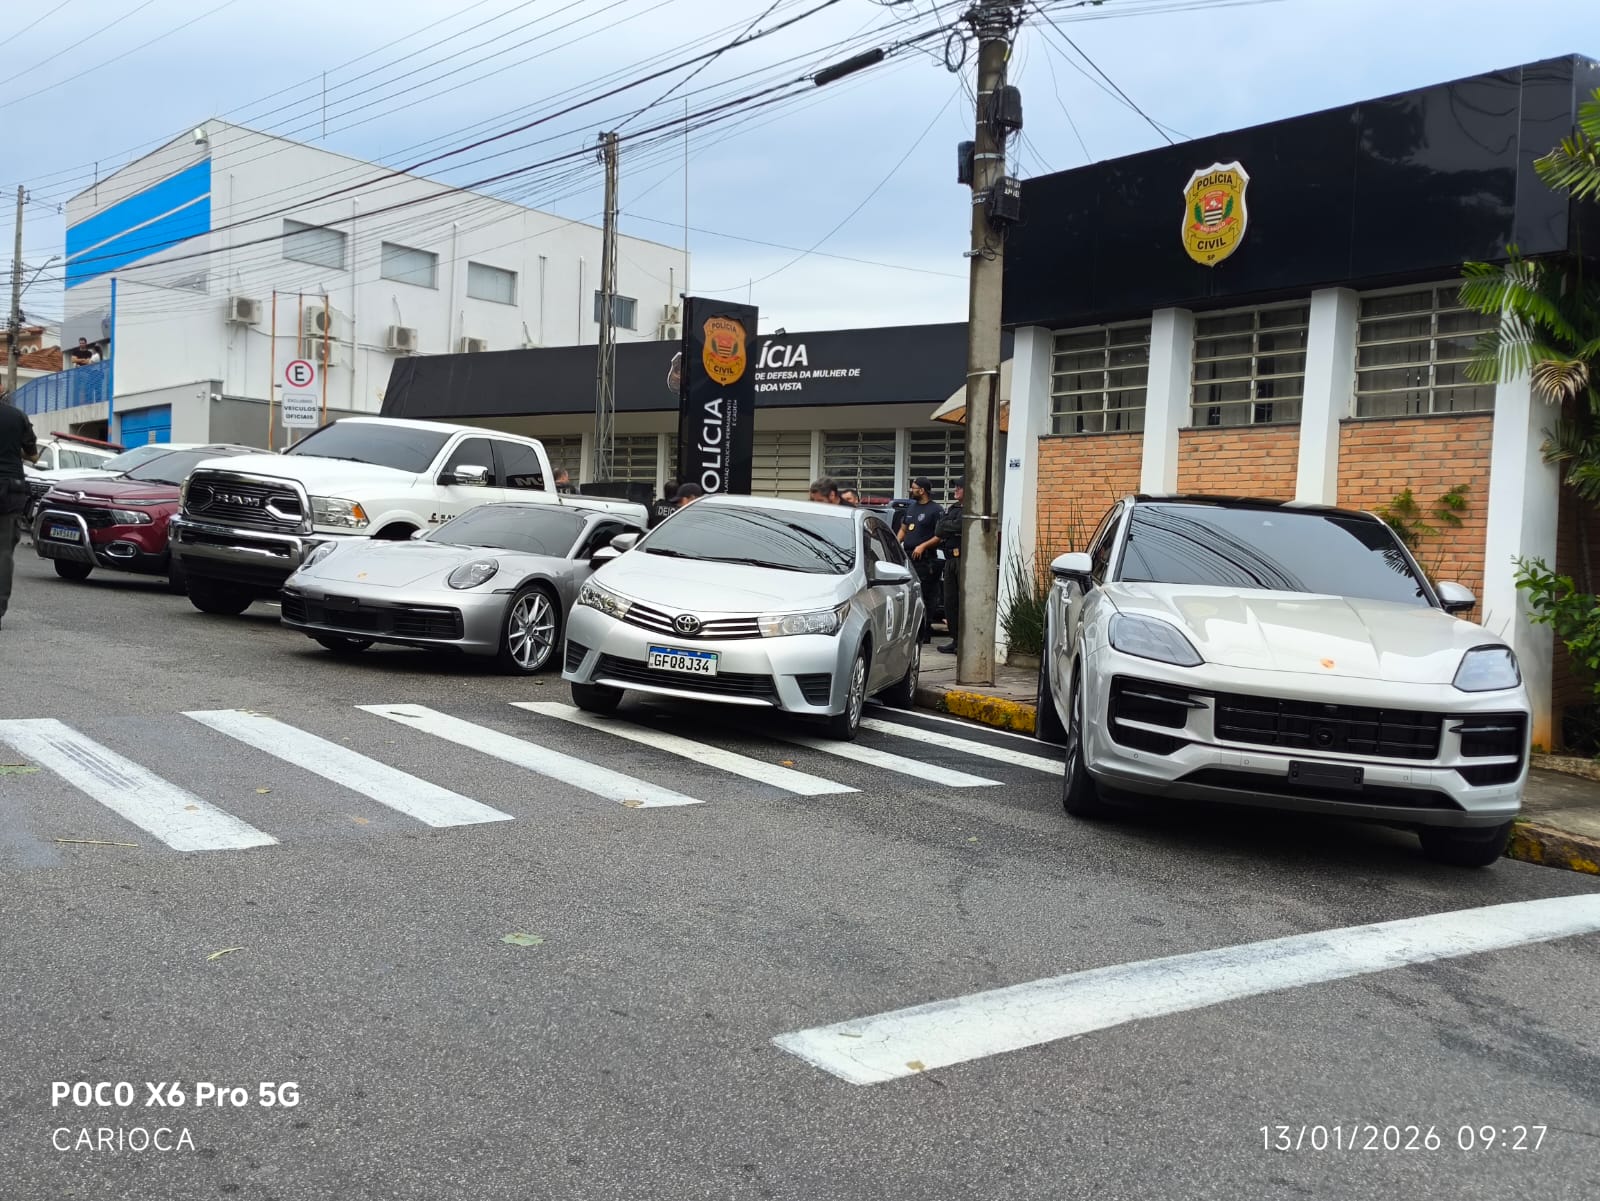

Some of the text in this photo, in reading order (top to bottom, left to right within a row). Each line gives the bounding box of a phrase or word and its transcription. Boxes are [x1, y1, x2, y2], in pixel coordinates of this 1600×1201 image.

[1197, 173, 1233, 190] POLÍCIA
[1197, 237, 1226, 250] CIVIL
[711, 321, 737, 333] POLÍCIA
[755, 340, 809, 369] ÍCIA
[294, 365, 305, 382] E
[713, 364, 734, 375] CIVIL
[755, 367, 861, 381] DE DEFESA DA MULHER DE
[760, 382, 778, 392] BOA
[779, 382, 802, 391] VISTA
[215, 494, 260, 507] RAM
[654, 654, 709, 672] GFQ8J34
